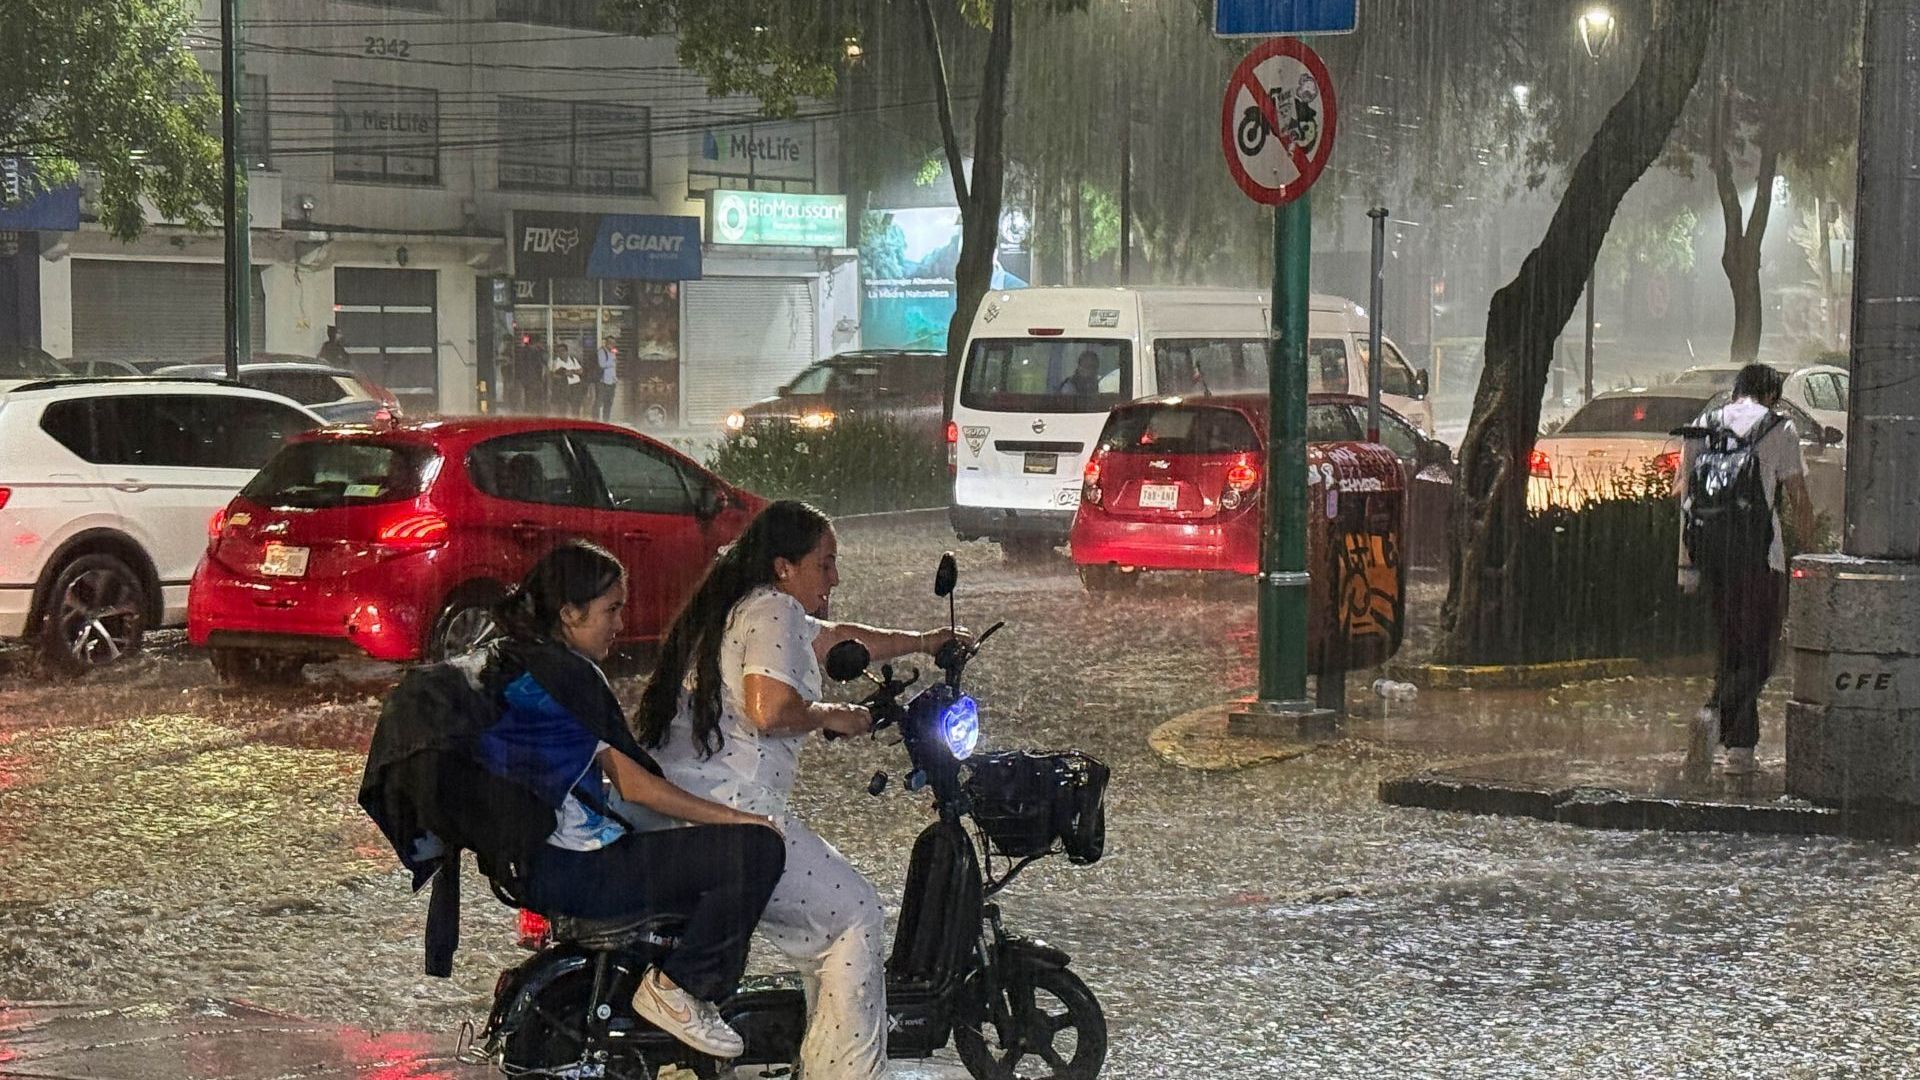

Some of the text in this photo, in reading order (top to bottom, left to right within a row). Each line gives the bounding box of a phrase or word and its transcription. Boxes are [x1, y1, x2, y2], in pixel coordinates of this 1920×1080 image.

[365, 36, 410, 57] 2342
[363, 110, 429, 133] MetLife
[730, 134, 800, 161] MetLife
[523, 226, 559, 253] FOX
[625, 234, 685, 252] GIANT
[1835, 672, 1892, 691] CFE
